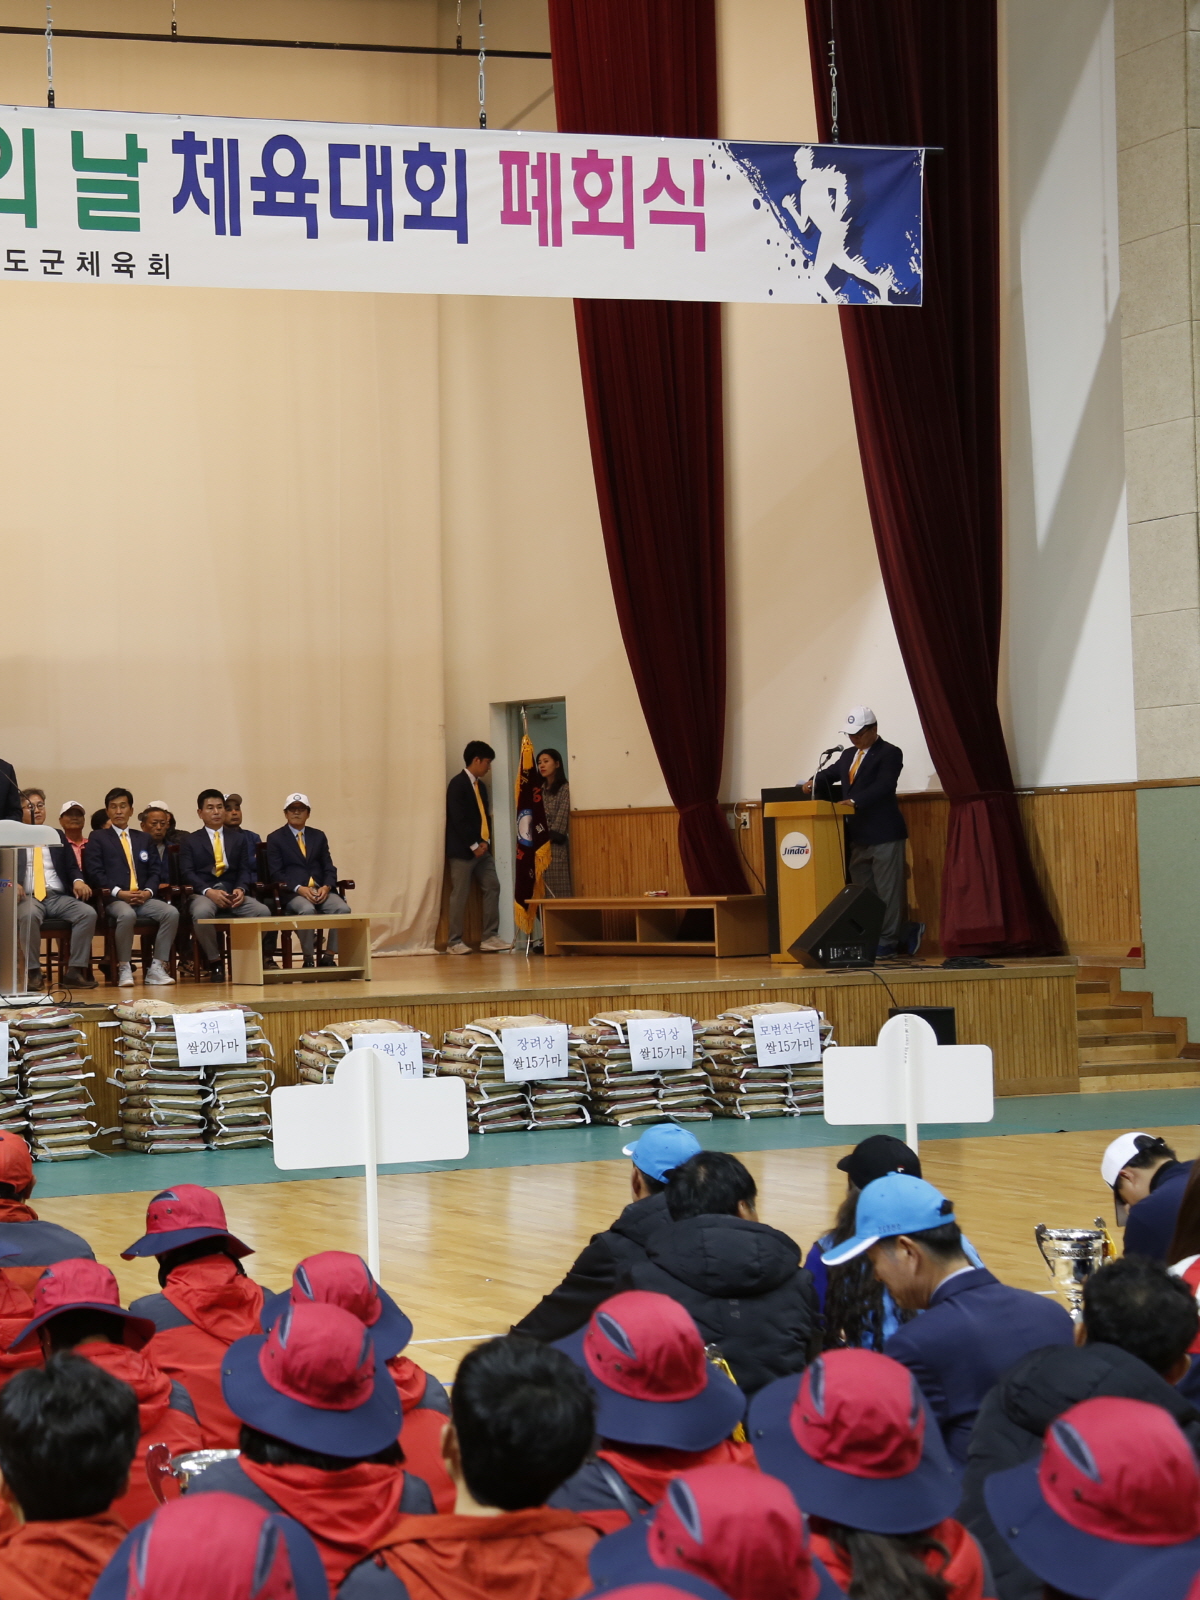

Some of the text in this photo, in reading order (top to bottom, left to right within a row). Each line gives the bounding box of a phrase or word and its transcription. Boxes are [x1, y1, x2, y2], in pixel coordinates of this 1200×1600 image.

[71, 129, 148, 233] 날
[172, 129, 469, 246] 체육대회
[499, 147, 707, 253] 폐회식
[782, 846, 805, 856] Jindo
[200, 1020, 220, 1034] 3위
[643, 1027, 680, 1042] 장려상
[760, 1020, 815, 1036] 모범선수단
[186, 1038, 239, 1055] 쌀20가마
[517, 1035, 555, 1051] 장려상
[765, 1037, 814, 1055] 쌀15가마
[639, 1045, 687, 1060] 쌀15가마
[512, 1054, 562, 1071] 쌀15가마
